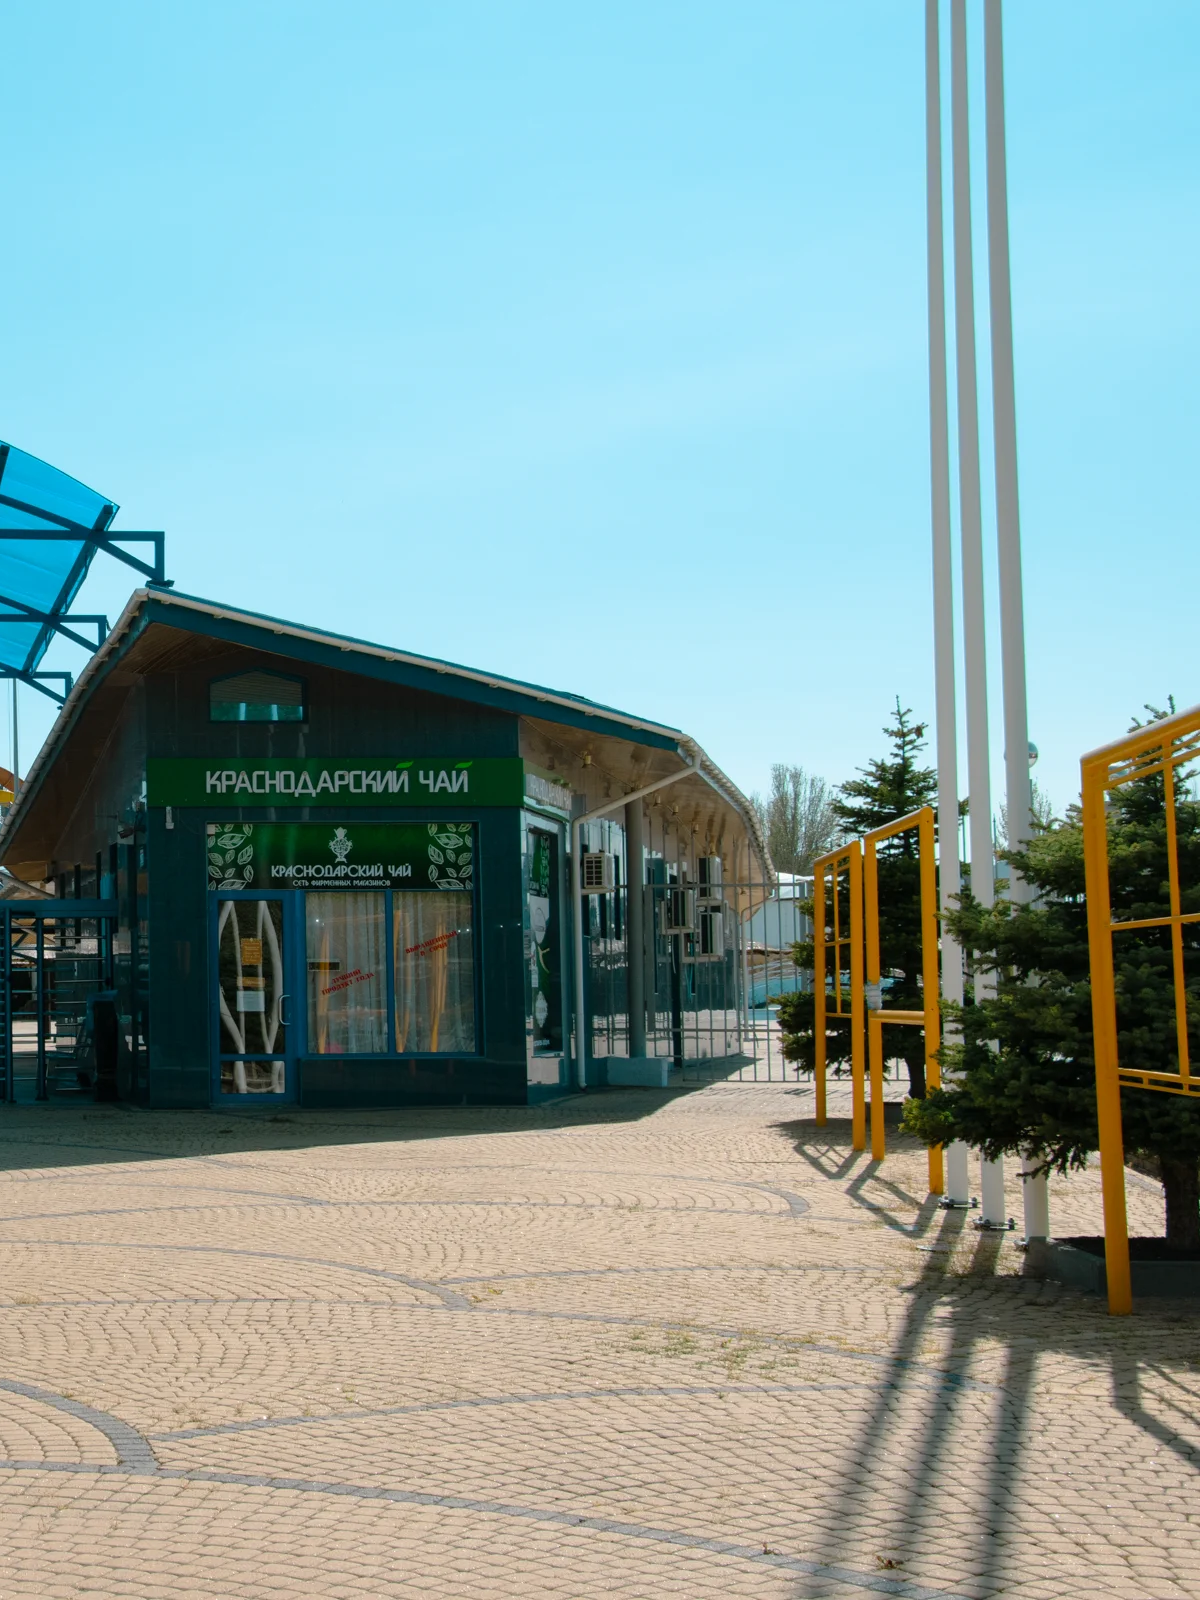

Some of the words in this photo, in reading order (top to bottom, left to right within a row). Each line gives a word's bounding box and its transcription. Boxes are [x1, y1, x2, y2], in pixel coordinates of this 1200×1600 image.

[205, 762, 412, 797] КРАСНОДАРСКИЙ
[418, 762, 471, 793] ЧАЙ
[271, 863, 383, 878] КРАСНОДАРСКИЙ
[387, 863, 412, 877] ЧАЙ
[292, 879, 309, 887] СЕТЬ
[310, 879, 351, 887] ФИРМЕННЫХ
[352, 879, 391, 887] МАГАЗИНОВ
[321, 980, 353, 995] ПРОДУКТ
[356, 972, 375, 982] ГОДА
